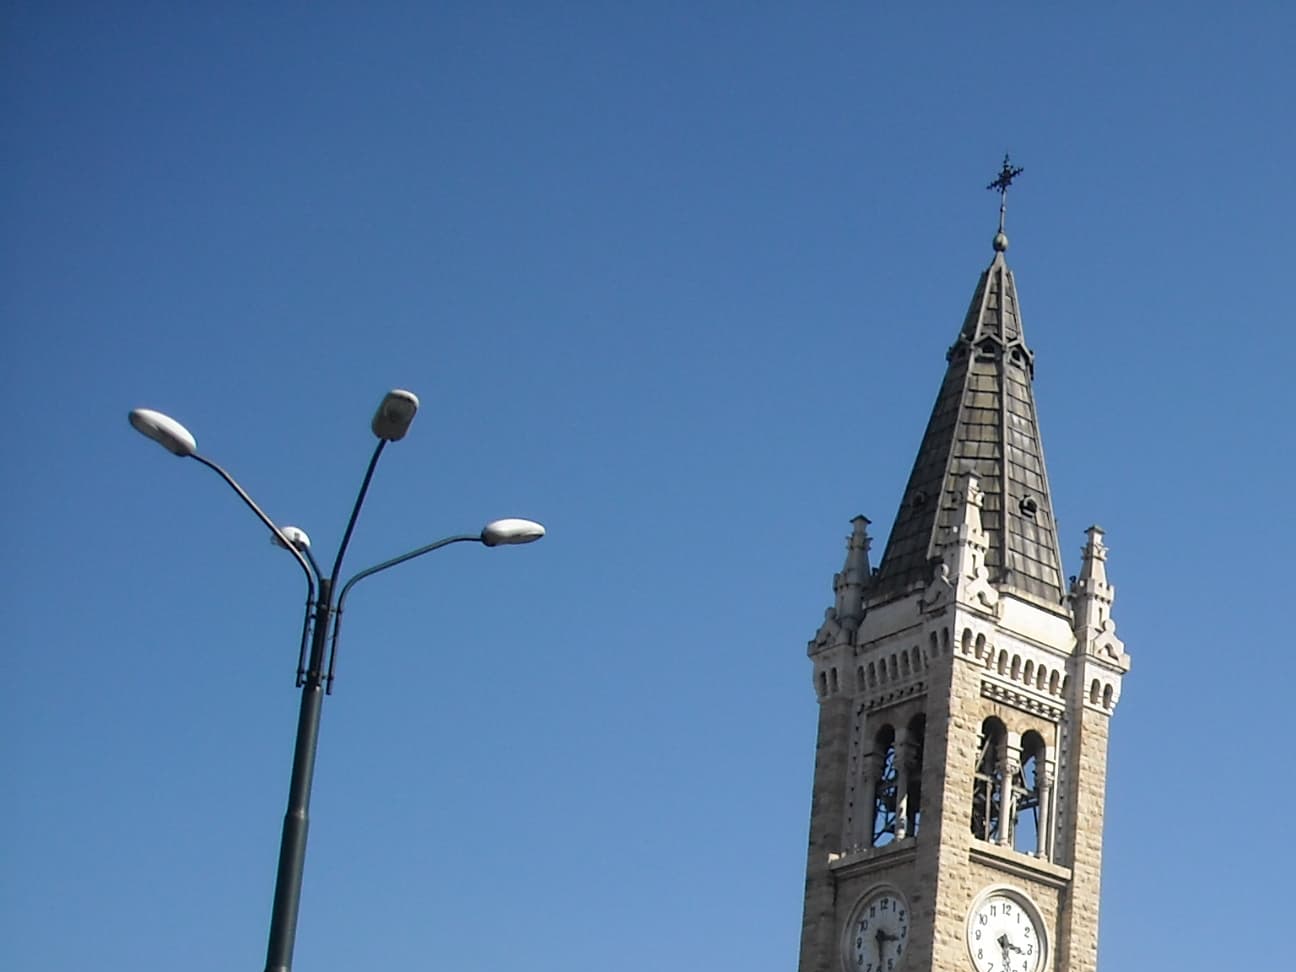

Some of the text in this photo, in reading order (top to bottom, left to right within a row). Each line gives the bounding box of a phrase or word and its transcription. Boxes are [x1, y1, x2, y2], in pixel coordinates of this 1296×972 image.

[880, 898, 888, 910] 12
[1002, 904, 1011, 915] 12
[870, 907, 875, 917] 11
[899, 910, 904, 921] 2
[990, 905, 996, 917] 11
[979, 914, 987, 925] 10
[860, 920, 868, 931] 10
[976, 930, 981, 940] 9
[1024, 927, 1030, 937] 2
[857, 938, 862, 948] 9
[897, 944, 901, 955] 4
[978, 949, 983, 959] 8
[1027, 944, 1032, 955] 3
[888, 959, 893, 970] 5
[1023, 960, 1027, 971] 4
